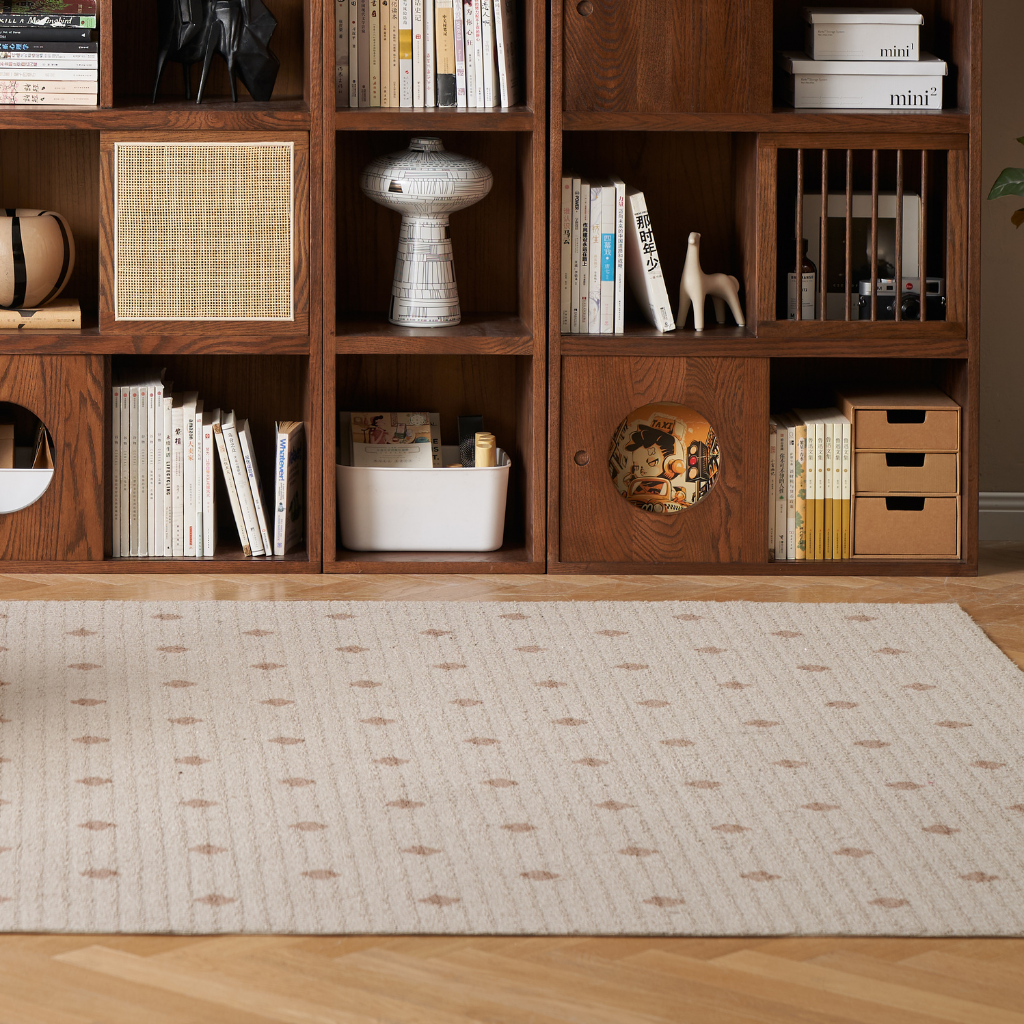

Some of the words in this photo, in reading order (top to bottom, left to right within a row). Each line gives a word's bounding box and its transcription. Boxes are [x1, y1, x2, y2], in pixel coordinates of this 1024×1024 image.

[603, 234, 612, 256] 四幕戏
[636, 214, 659, 273] 那时年少
[651, 419, 674, 430] TAXI
[278, 438, 287, 481] Whatever!
